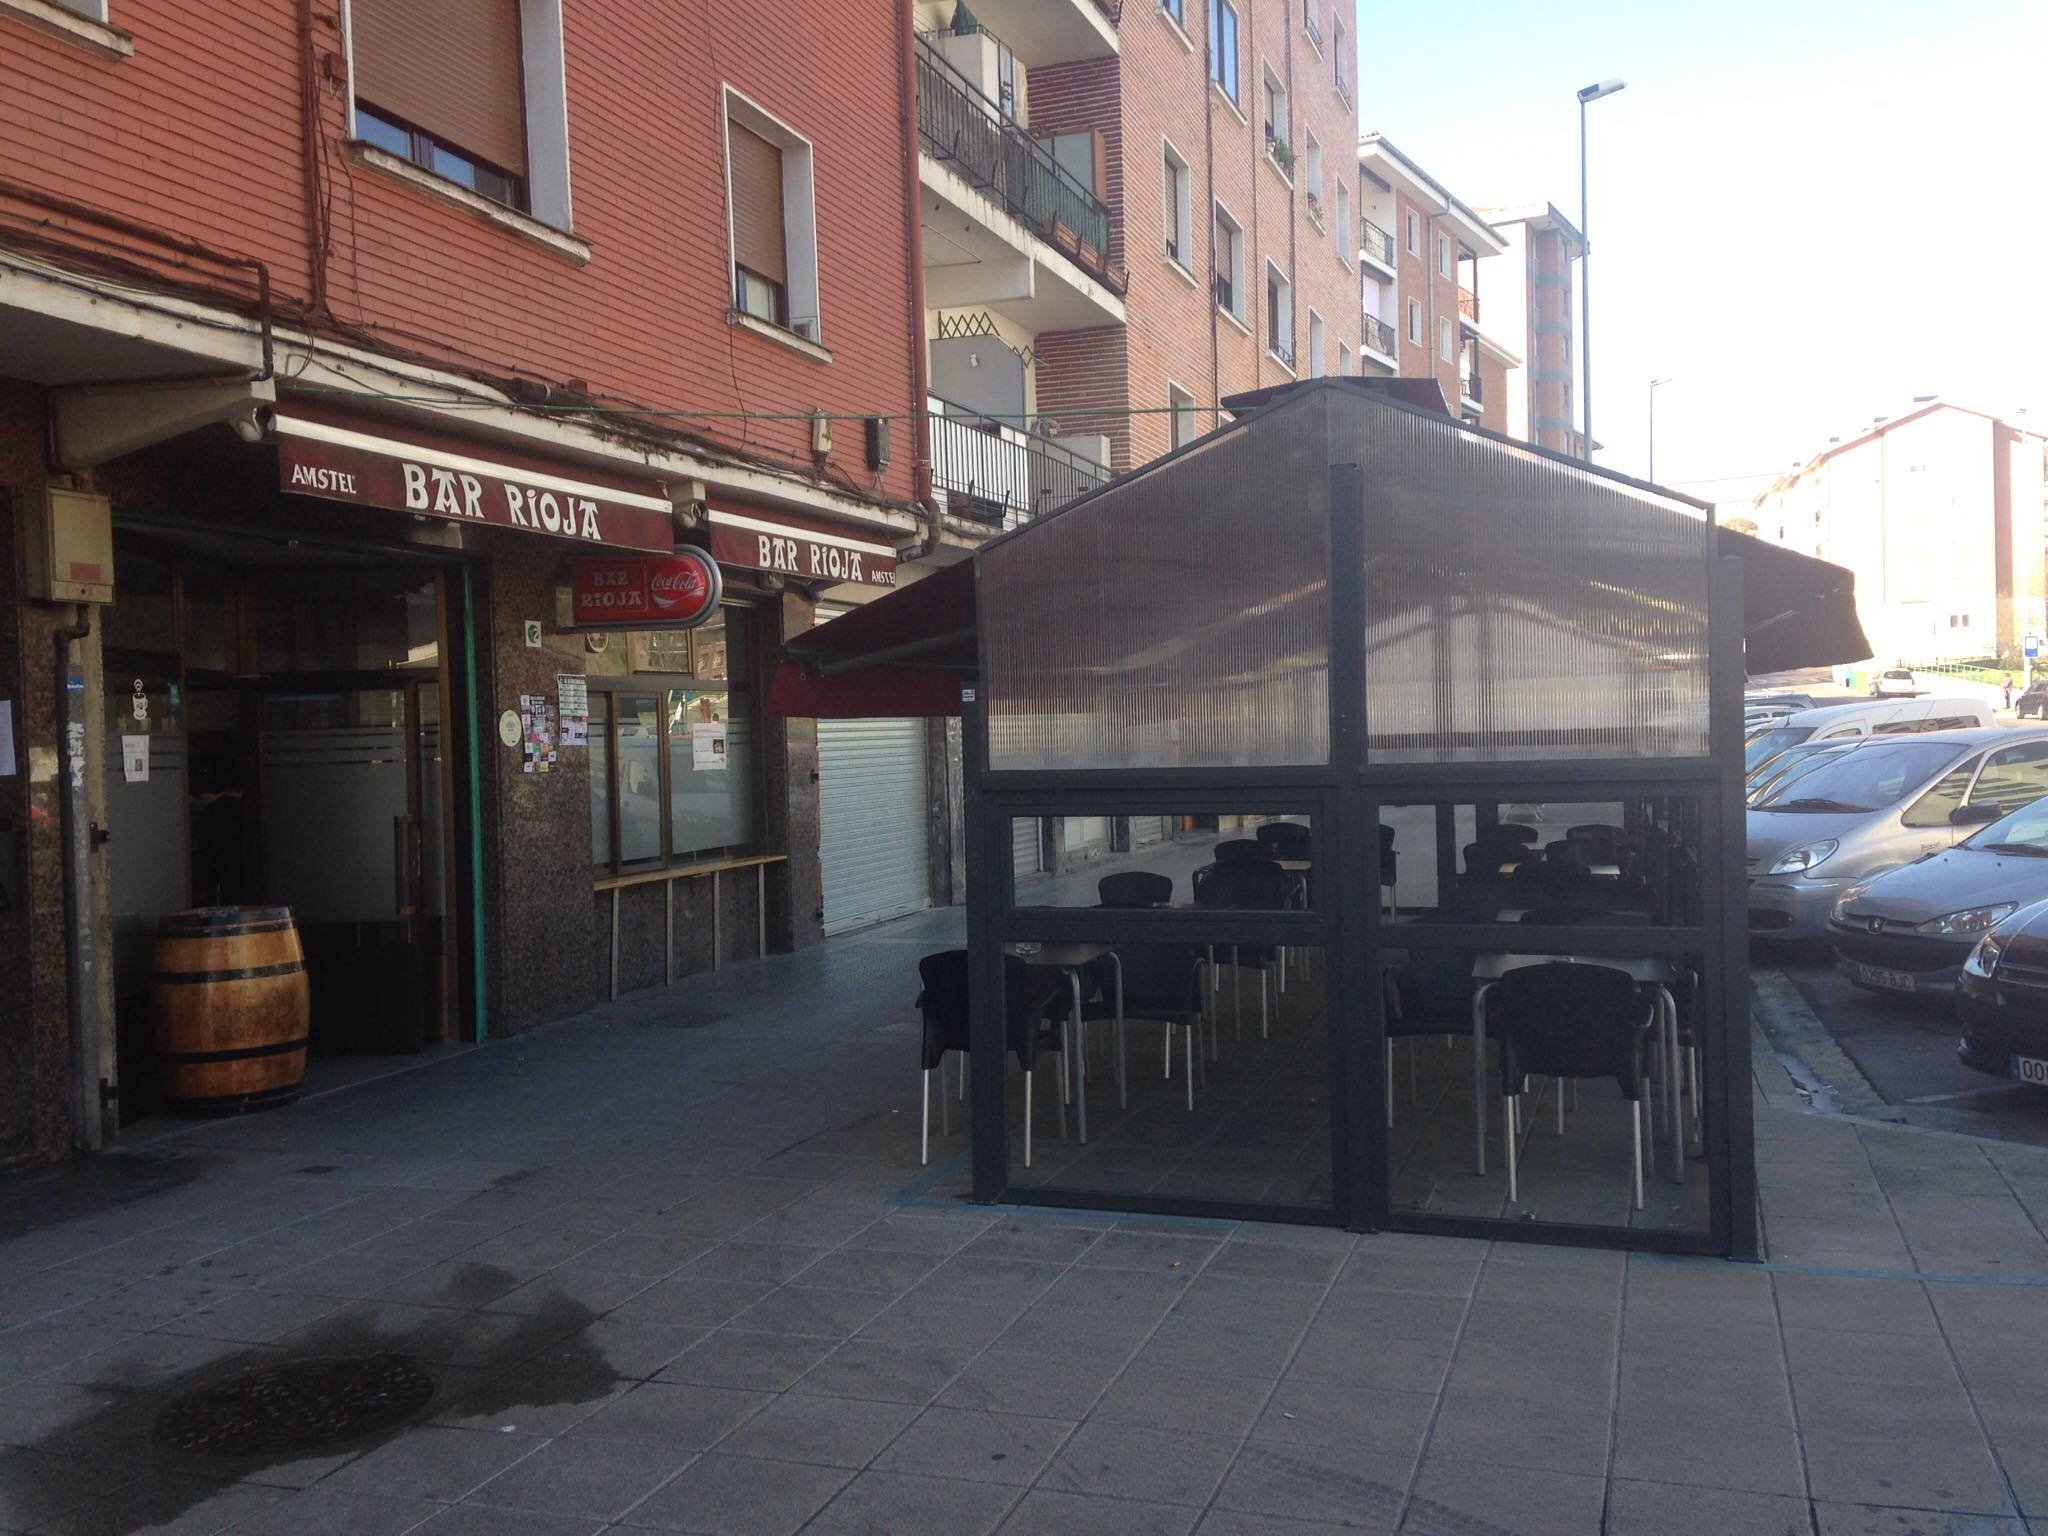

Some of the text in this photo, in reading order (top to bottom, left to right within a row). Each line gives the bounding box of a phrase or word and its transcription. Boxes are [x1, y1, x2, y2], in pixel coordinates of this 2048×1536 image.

[292, 464, 356, 494] AMSTEL
[402, 463, 485, 519] BAR
[758, 535, 799, 571] BAR
[593, 571, 629, 587] BAR
[2023, 1060, 2048, 1081] 00
